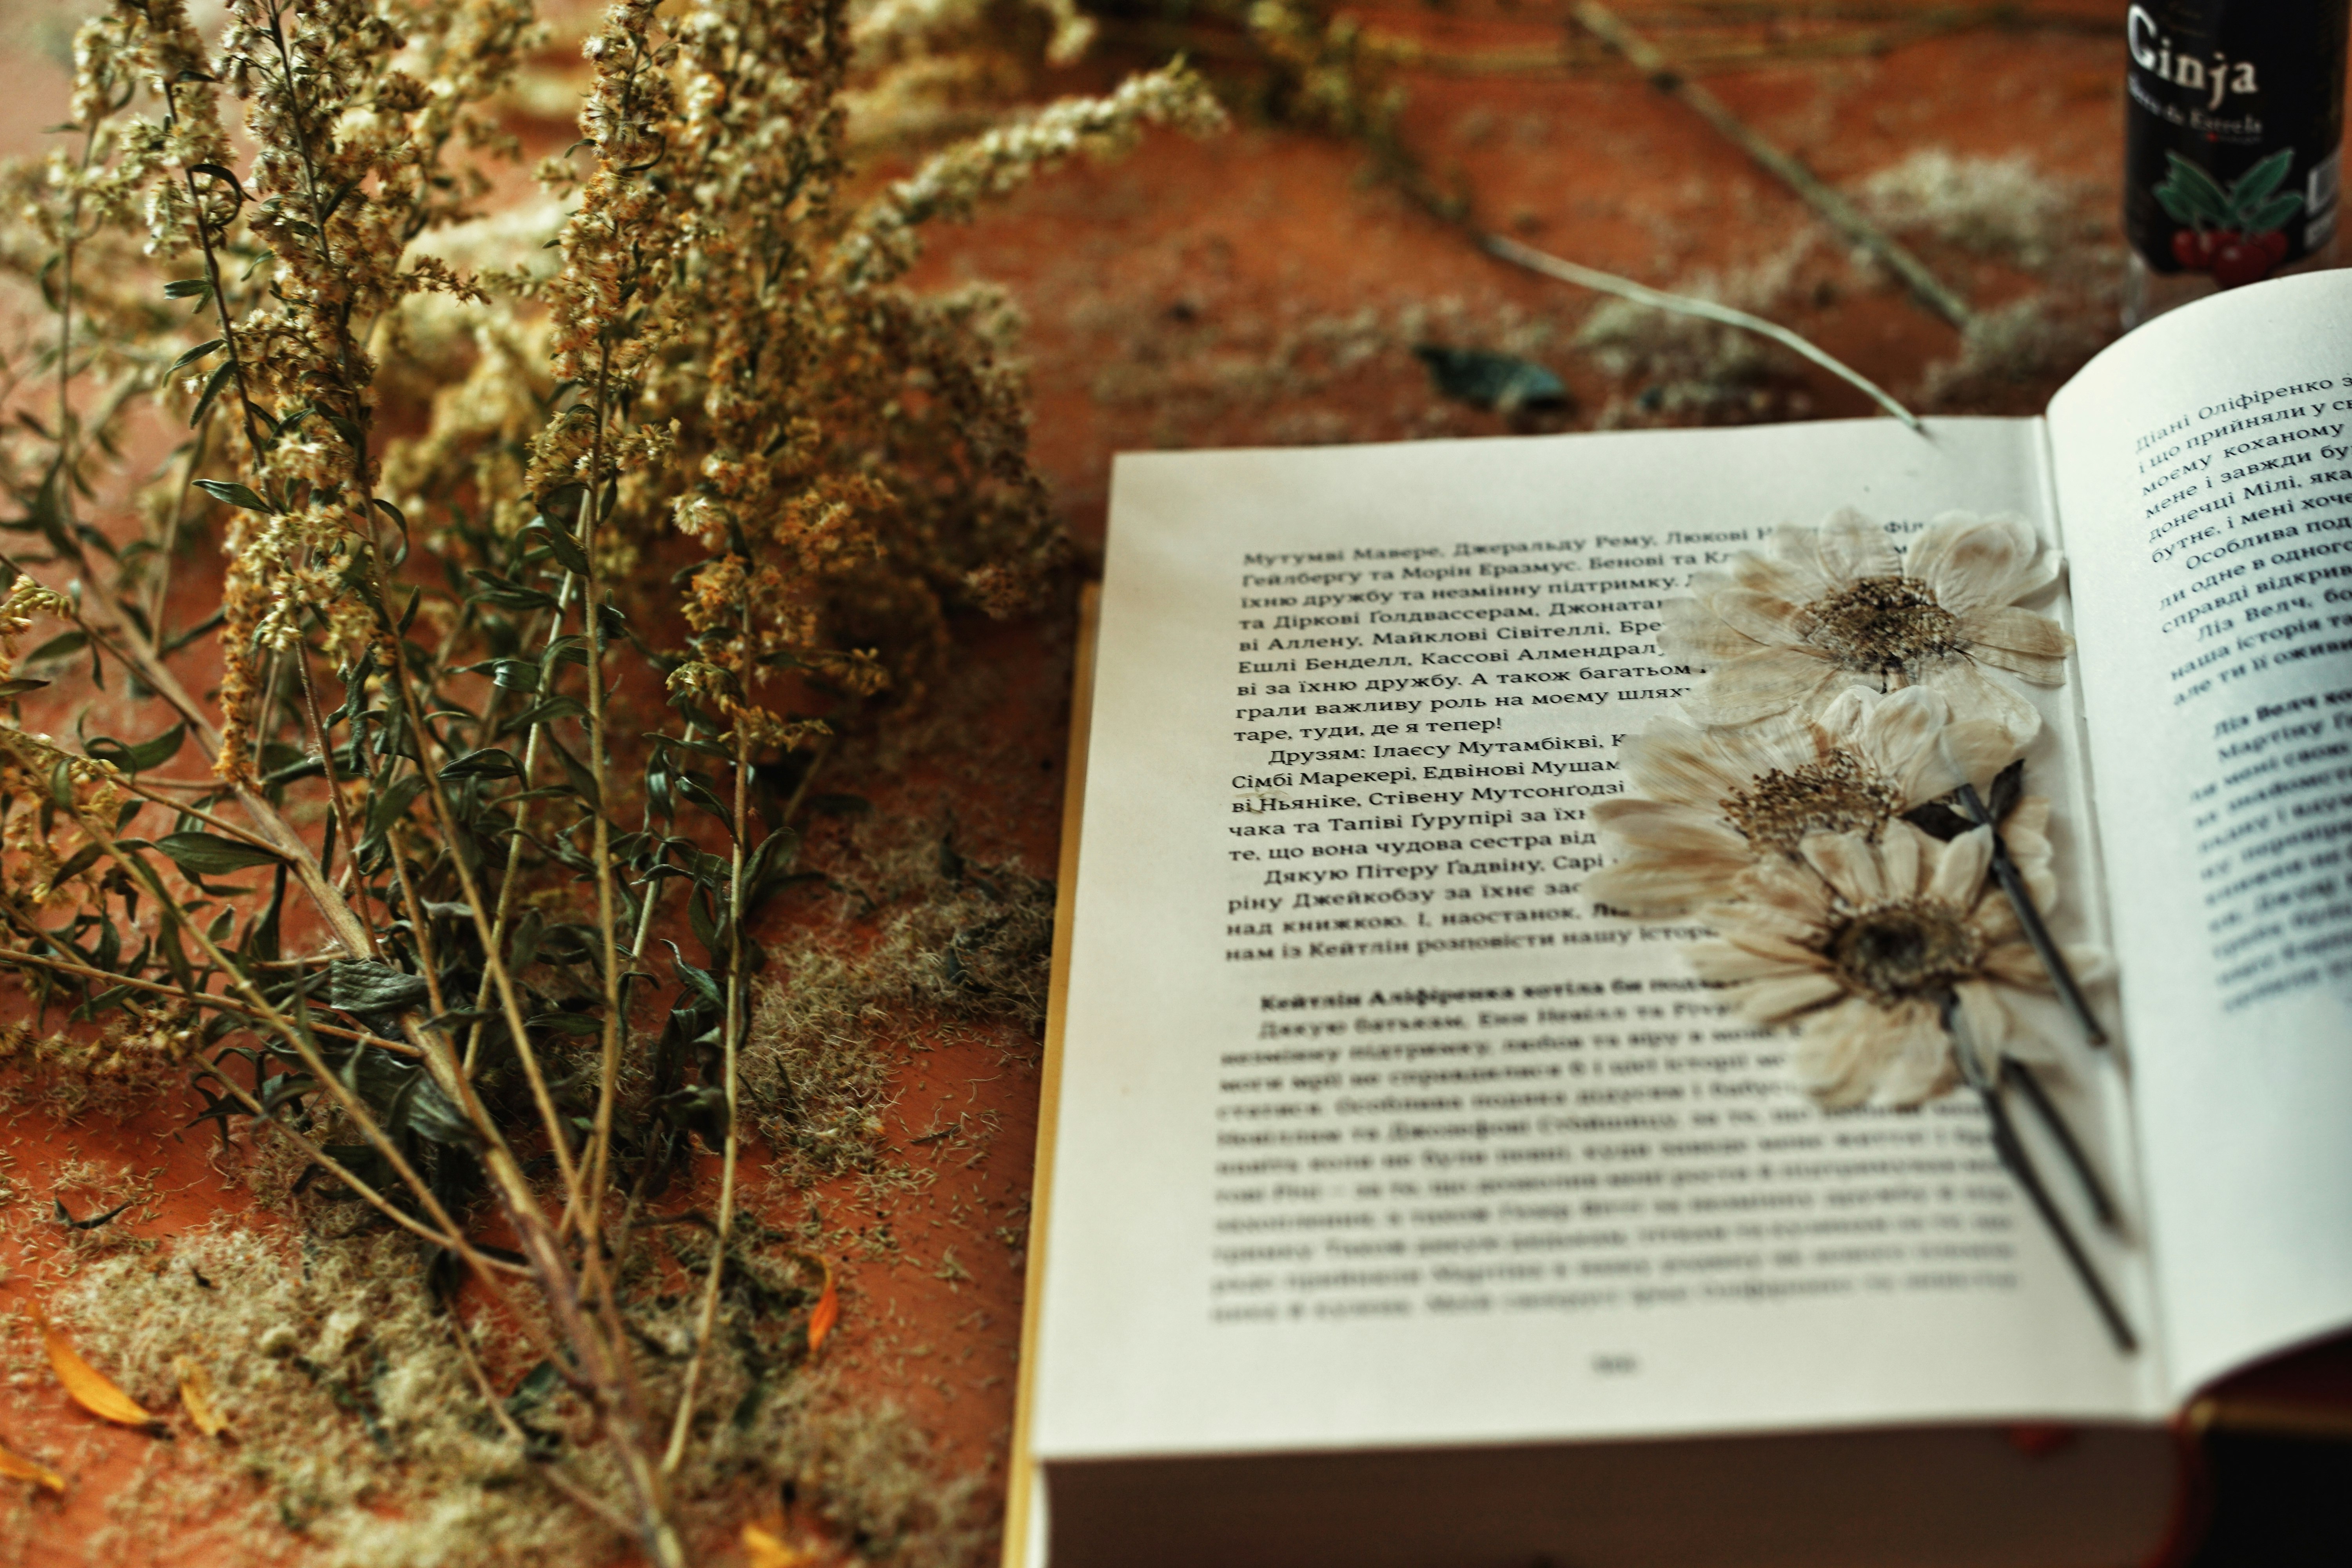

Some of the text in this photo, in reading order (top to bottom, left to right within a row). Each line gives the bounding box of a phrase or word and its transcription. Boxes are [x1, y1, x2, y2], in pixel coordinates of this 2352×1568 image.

[2135, 414, 2190, 454] Діані
[2198, 379, 2334, 420] Оліфіренко
[2139, 461, 2145, 474] і
[2150, 446, 2180, 467] що
[2186, 407, 2306, 448] прийняли
[2310, 403, 2326, 417] у
[2143, 423, 2344, 495] моєму коханому
[2146, 485, 2198, 518] мене
[2205, 476, 2212, 488] і
[2220, 452, 2312, 483] завжди
[2149, 494, 2235, 543] донечці
[2310, 470, 2352, 484] яка
[2227, 516, 2234, 529] і
[2241, 499, 2295, 525] мені
[1453, 539, 1586, 557] Джеральду
[1667, 529, 1749, 544] Люкові
[2186, 526, 2299, 570] Особлива
[1371, 571, 1394, 581] та
[1402, 565, 1471, 581] Морін
[1589, 554, 1664, 570] Бенові
[1672, 555, 1697, 565] та
[1241, 597, 1298, 609] їхню
[1303, 590, 1393, 608] дружбу
[1400, 591, 1425, 601] та
[1432, 585, 1541, 599] незмінну
[2159, 589, 2186, 610] ли
[2191, 565, 2246, 593] одне
[2252, 559, 2266, 571] в
[1239, 619, 1265, 630] та
[1273, 612, 1359, 630] Діркові
[2162, 585, 2249, 633] справді
[1239, 639, 1258, 652] ві
[1372, 628, 1488, 645] Майклові
[2197, 619, 2234, 642] Ліз
[1238, 659, 1296, 674] Ешлі
[1421, 649, 1509, 665] Кассові
[2171, 646, 2230, 681] наша
[2236, 619, 2321, 651] історія
[1237, 665, 1691, 696] ві за їхню дружбу. А також багатьом
[2174, 680, 2211, 706] але
[2220, 664, 2247, 682] ти
[1236, 688, 1690, 722] грали важливу роль на моєму шлях
[1233, 717, 1501, 744] таре, туди, де я тепер!
[1268, 749, 1365, 766] Друзям:
[1373, 745, 1451, 759] Ілаєсу
[1457, 735, 1604, 757] Мутамбікві,
[1232, 773, 1293, 789] Сімбі
[1299, 767, 1417, 787] Марекері,
[1423, 762, 1525, 780] Едвінові
[1232, 798, 1251, 813] ві
[1259, 794, 1362, 812] Ньяніке,
[1368, 791, 1464, 806] Стівену
[1228, 824, 1285, 837] чака
[1293, 822, 1320, 834] та
[1327, 815, 1403, 831] Тапіві
[1411, 809, 1512, 831] Ґурупірі
[1521, 811, 1546, 822] за
[1228, 831, 1596, 861] те, що вона чудова сестра від
[1263, 869, 1349, 886] Дякую
[1356, 864, 1439, 880] Пітеру
[1552, 855, 1602, 872] Сарі
[1228, 896, 1283, 915] ріну
[1292, 888, 1435, 909] Джейкобзу
[1445, 888, 1472, 900] за
[1481, 885, 1534, 899] їхнє
[1227, 922, 1273, 936] над
[1225, 947, 1275, 962] нам
[1282, 941, 1303, 958] із
[1308, 940, 1410, 958] Кейтлін
[1416, 934, 1555, 957] розповісти
[1562, 931, 1631, 945] нашу
